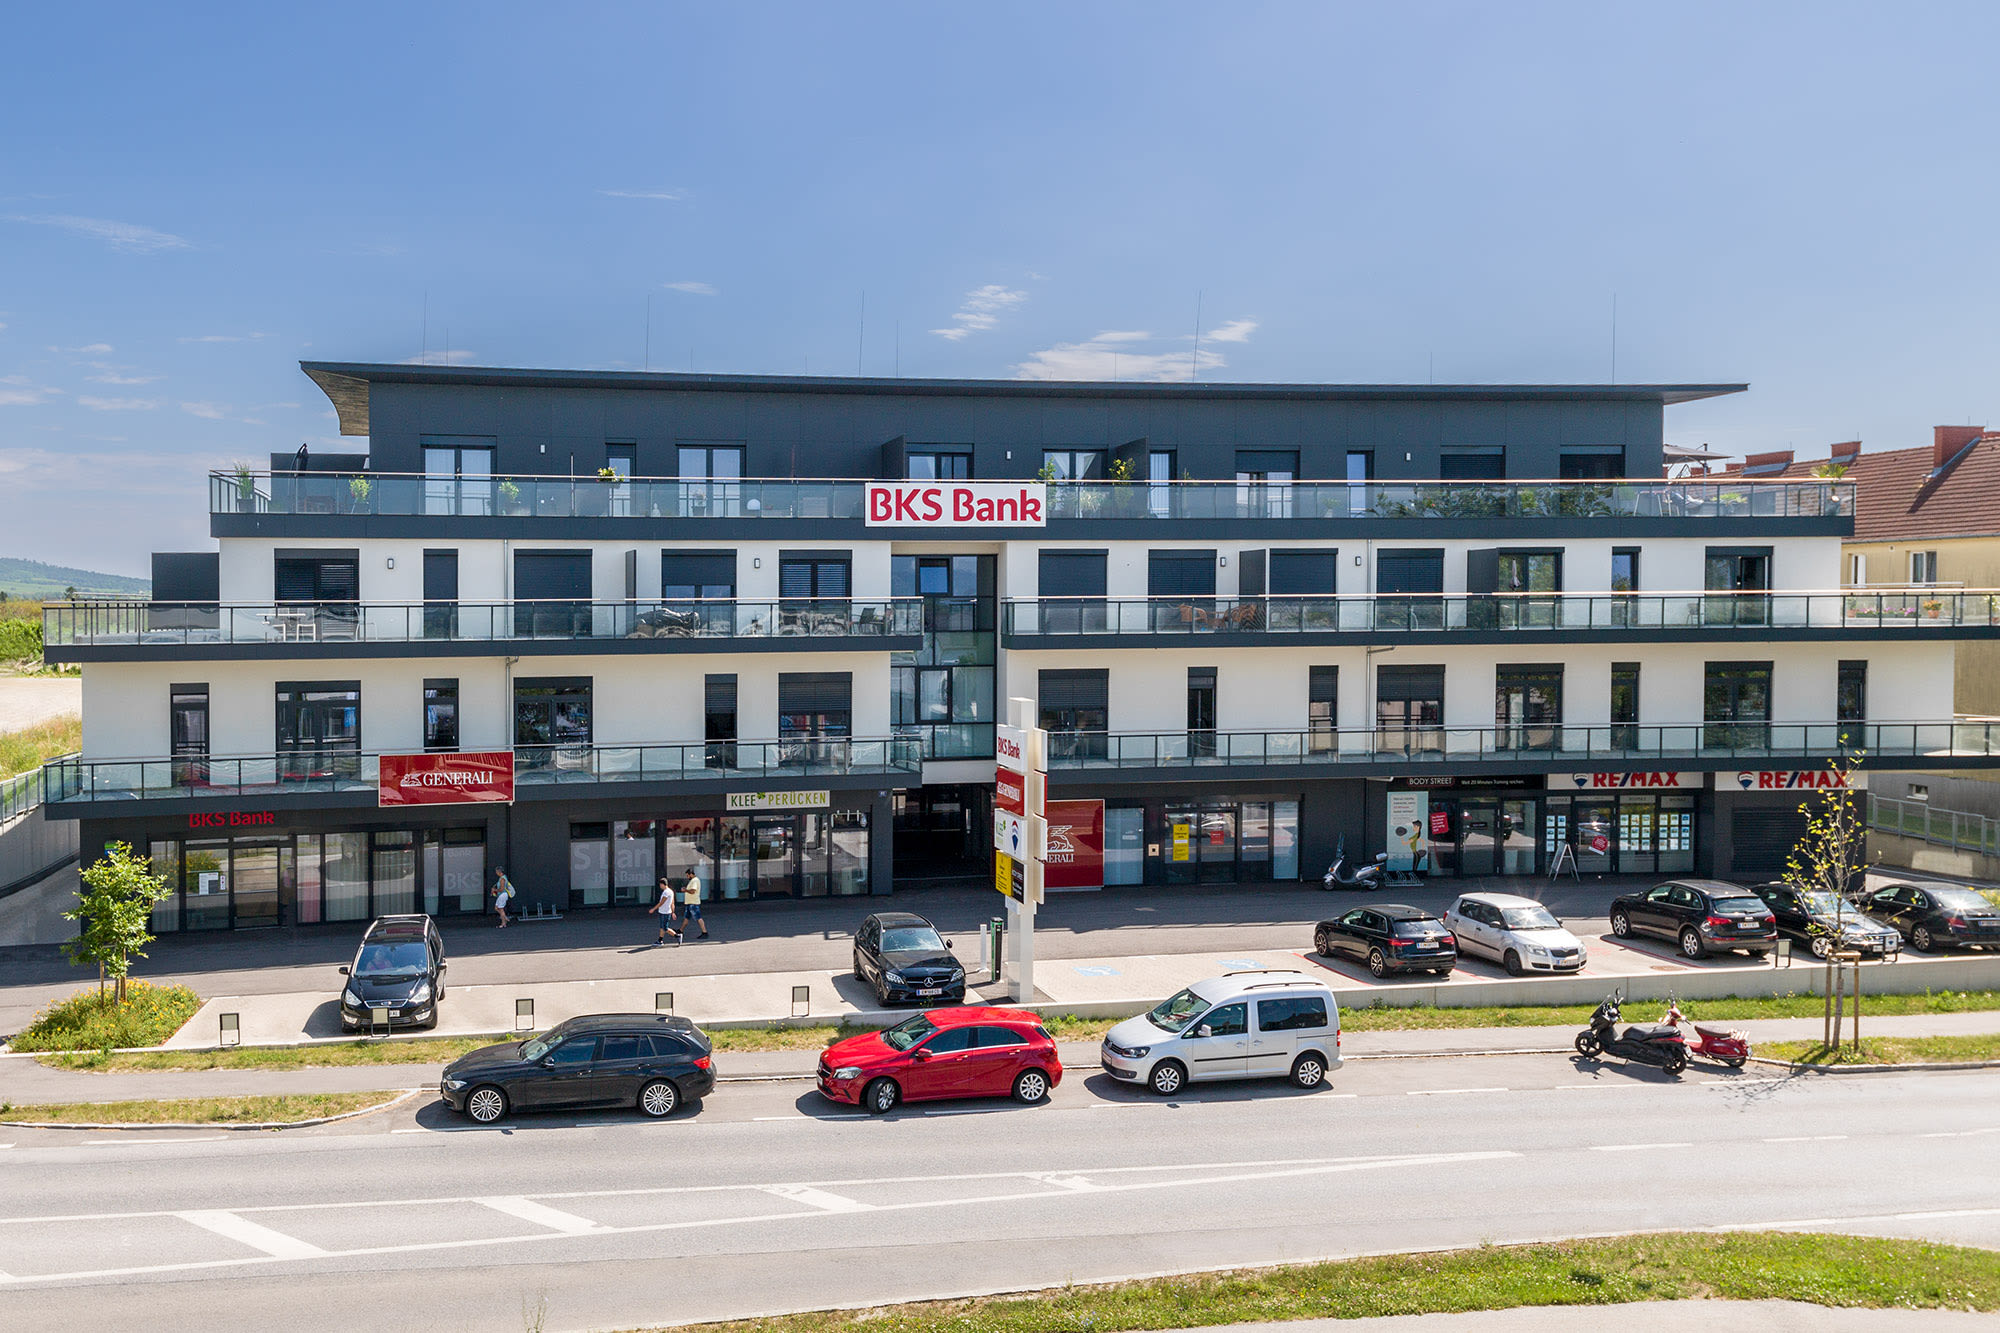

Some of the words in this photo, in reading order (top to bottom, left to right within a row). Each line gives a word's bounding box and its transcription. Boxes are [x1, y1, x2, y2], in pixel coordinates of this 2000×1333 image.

[870, 488, 943, 522] BKS
[953, 488, 1042, 522] Bank
[997, 736, 1008, 755] BKS
[1008, 740, 1021, 760] Bank
[423, 771, 494, 787] GENERALI
[1409, 777, 1429, 785] BODY
[1430, 777, 1453, 785] STREET
[1593, 772, 1680, 788] RE/MAX
[1758, 771, 1849, 789] RE/MAX
[731, 795, 756, 807] KLEE
[768, 791, 827, 806] PERÜCKEN
[189, 812, 226, 828] BKS
[230, 810, 275, 826] Bank
[444, 872, 482, 890] BKS
